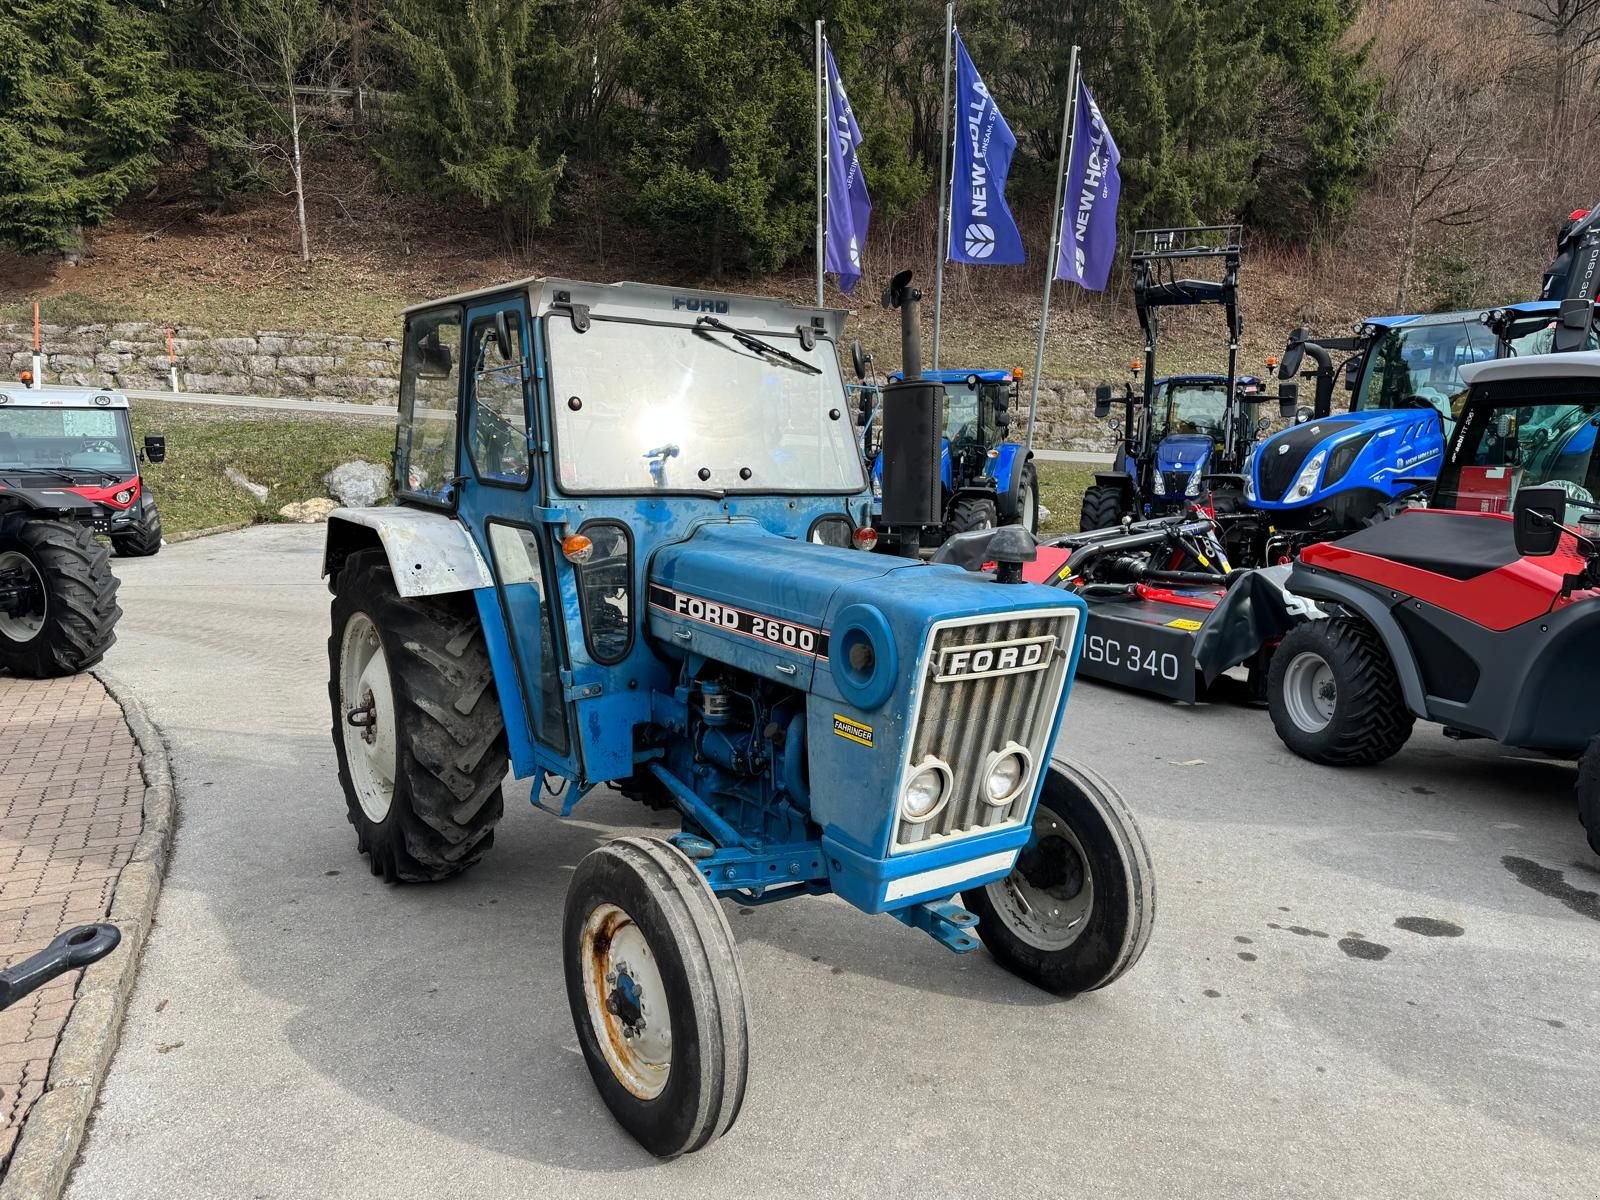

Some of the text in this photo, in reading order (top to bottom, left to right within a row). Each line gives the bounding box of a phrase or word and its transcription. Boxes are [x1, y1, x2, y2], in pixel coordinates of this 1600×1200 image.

[972, 163, 987, 216] NEW
[1075, 188, 1096, 242] NEW
[1584, 249, 1599, 279] DISC
[674, 296, 729, 314] FORD
[674, 593, 814, 651] FORD 2600
[948, 644, 1042, 675] FORD
[1127, 645, 1178, 681] 340
[834, 720, 872, 741] FAHRINGER
